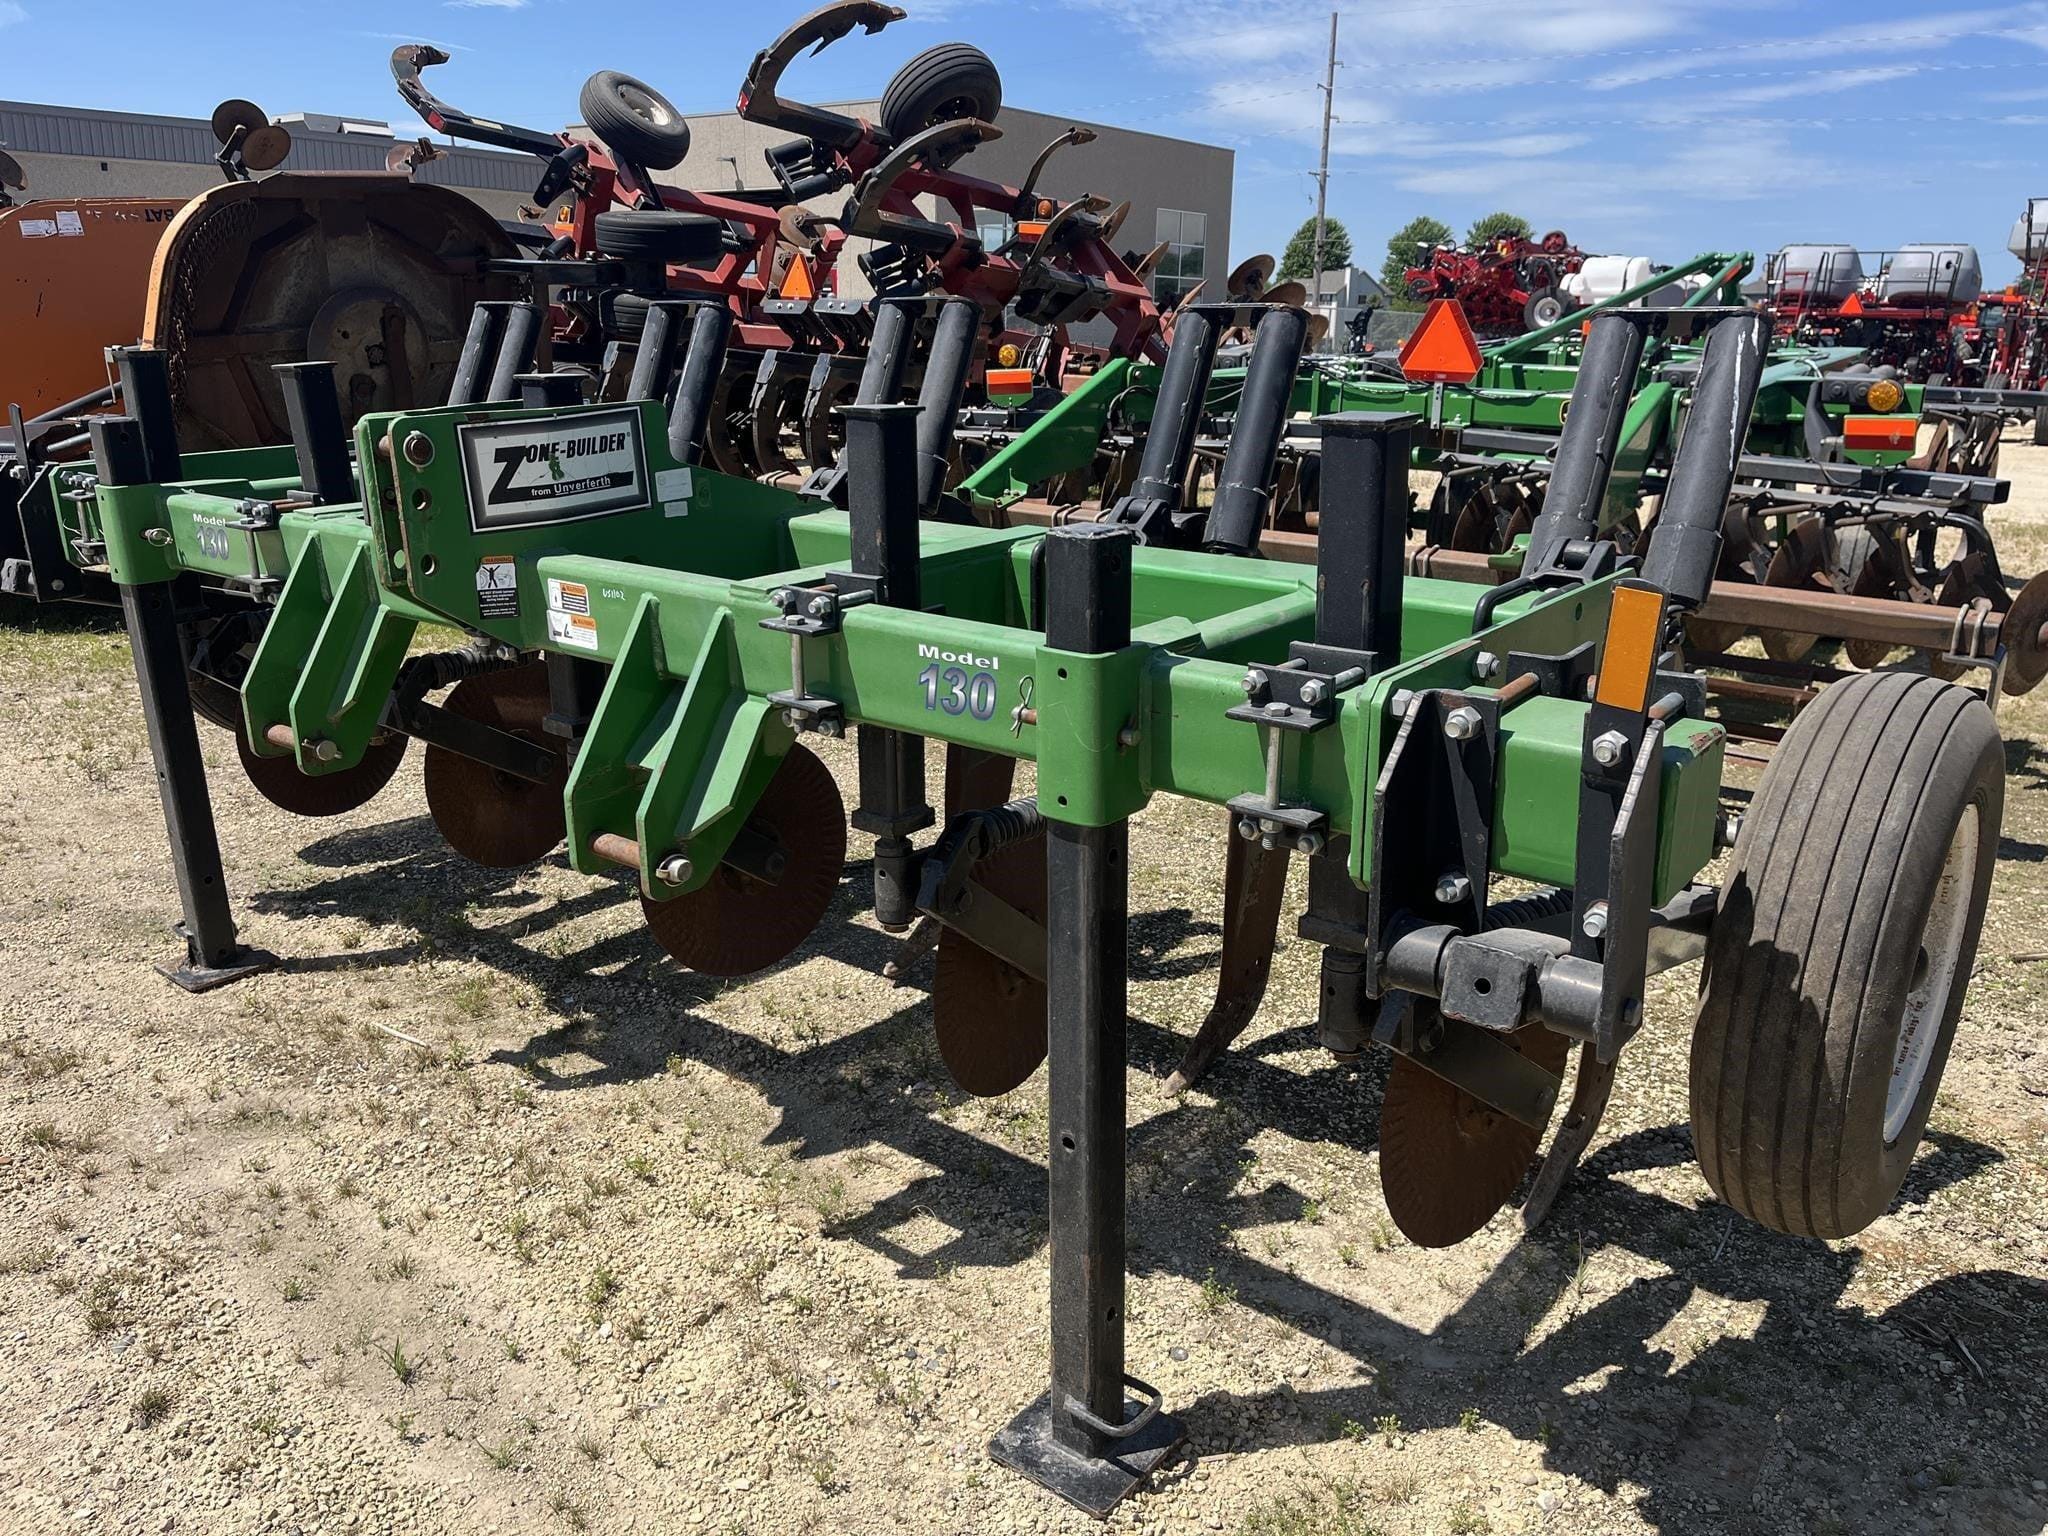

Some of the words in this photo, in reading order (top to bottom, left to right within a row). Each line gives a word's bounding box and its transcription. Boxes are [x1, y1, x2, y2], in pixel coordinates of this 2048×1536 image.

[531, 487, 552, 497] from
[553, 476, 612, 496] Unverferth
[192, 513, 226, 527] Model
[196, 526, 230, 561] 130
[918, 643, 999, 670] Model
[919, 663, 997, 721] 130
